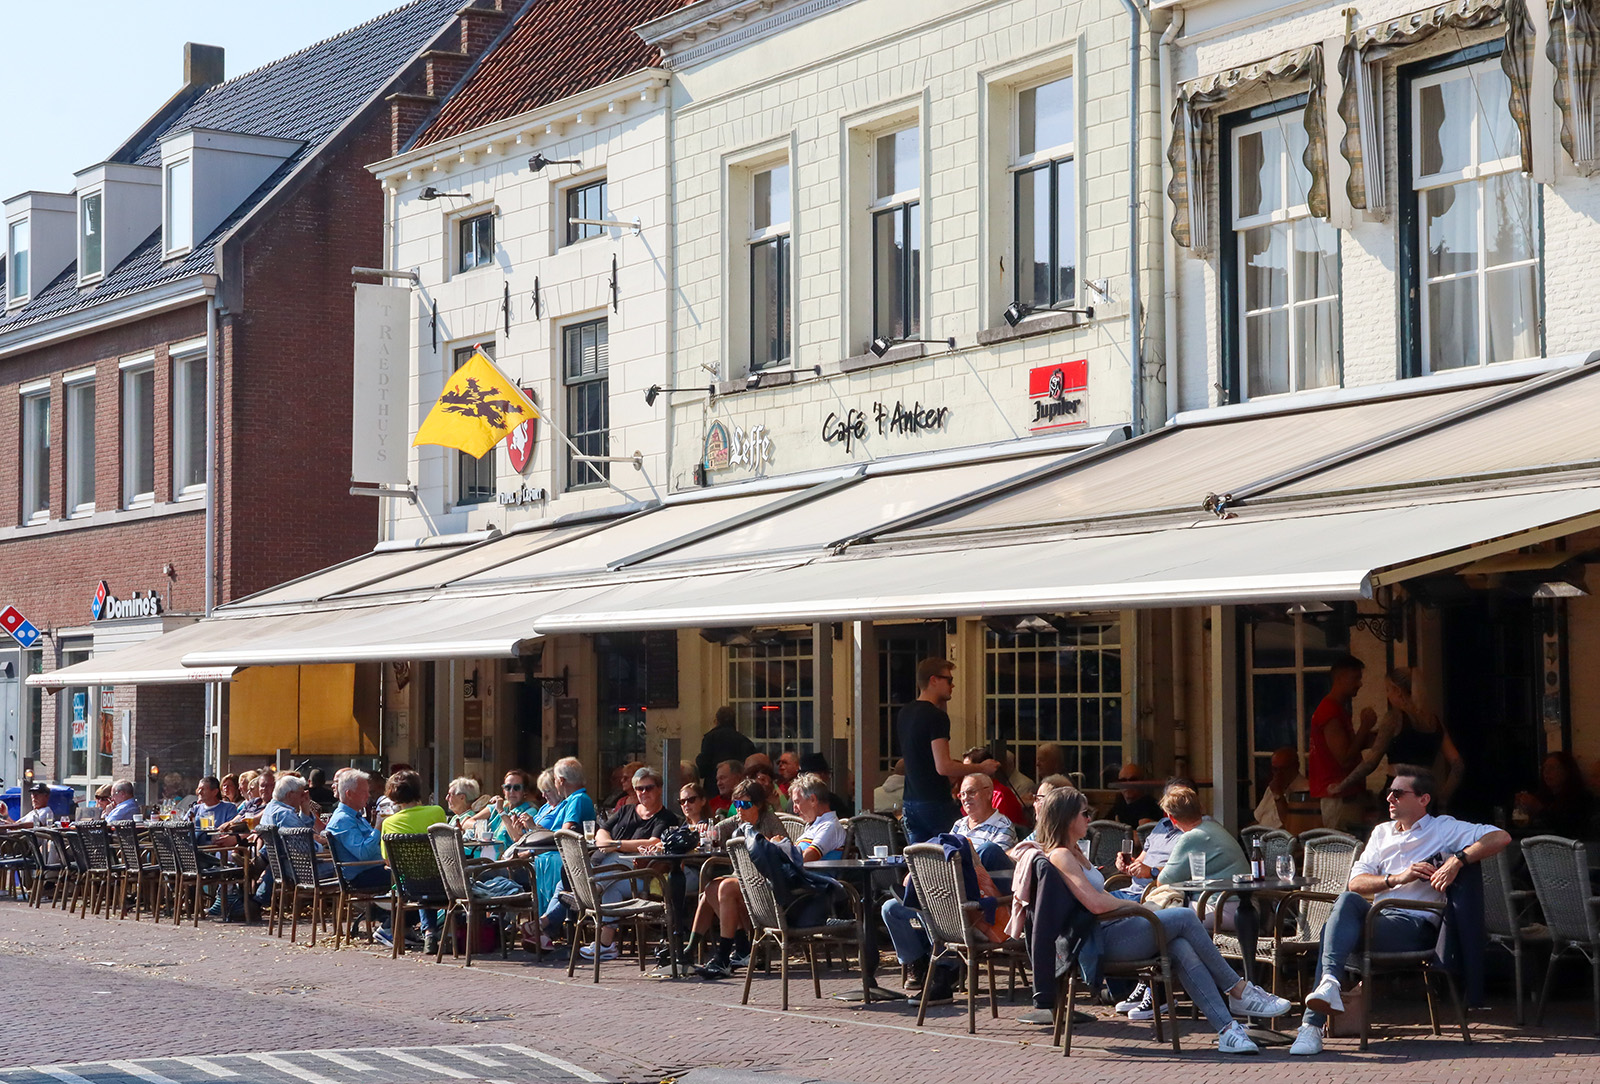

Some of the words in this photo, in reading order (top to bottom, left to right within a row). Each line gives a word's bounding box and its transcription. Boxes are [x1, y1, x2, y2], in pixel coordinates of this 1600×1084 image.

[376, 325, 393, 462] RAEDTHUYS
[1032, 397, 1082, 423] Jupiler
[729, 424, 771, 472] Leffe
[822, 408, 866, 454] Café
[890, 400, 948, 435] Anker
[106, 589, 158, 619] Domino's
